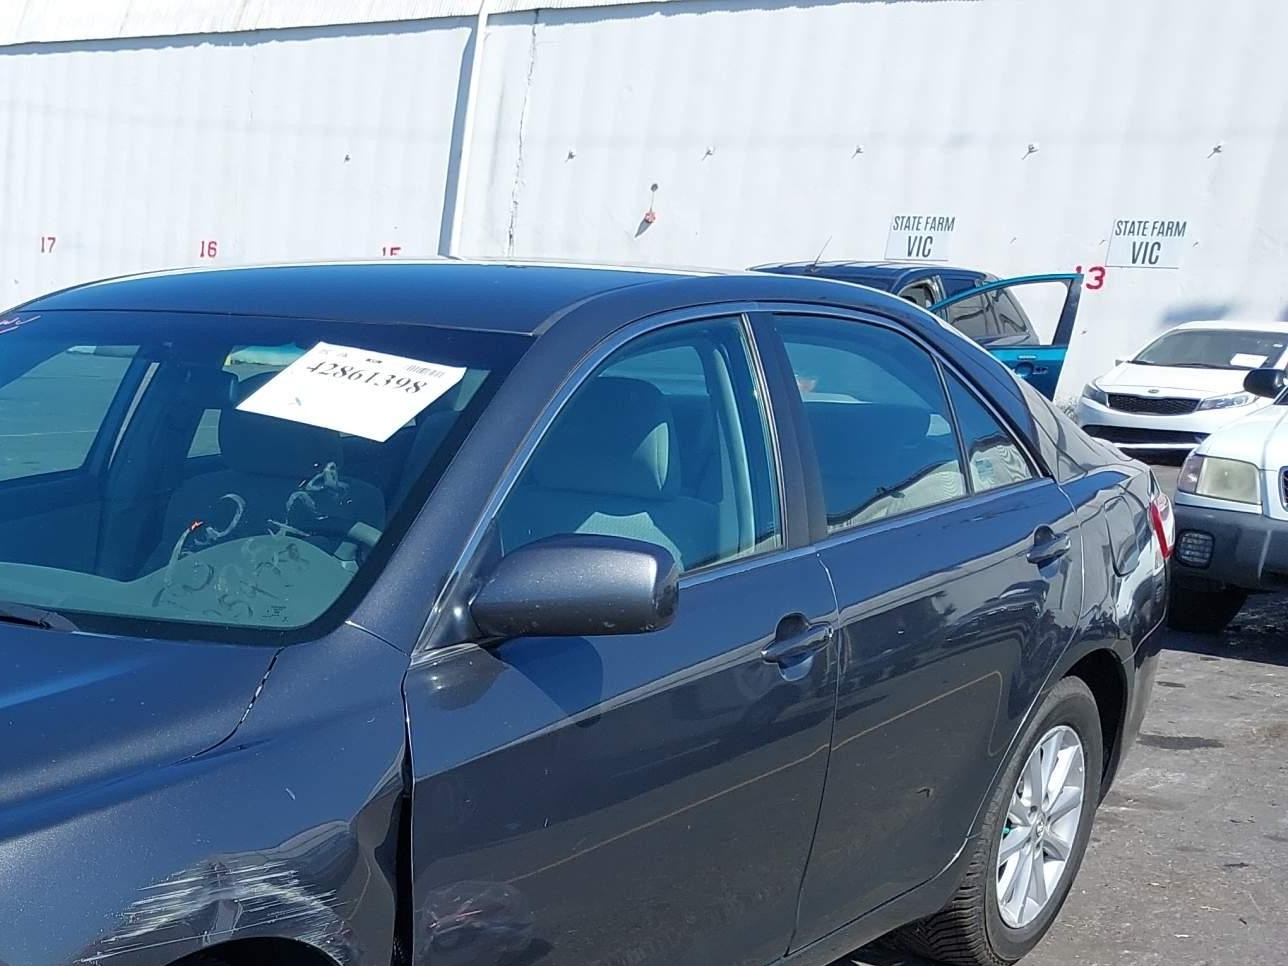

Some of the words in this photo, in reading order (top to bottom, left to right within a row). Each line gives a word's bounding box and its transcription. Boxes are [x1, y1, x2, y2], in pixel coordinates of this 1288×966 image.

[892, 215, 923, 231] STATE
[924, 215, 956, 232] FARM
[1114, 219, 1150, 237] STATE
[1150, 219, 1187, 238] FARM
[40, 236, 57, 254] 17
[199, 240, 219, 258] 16
[907, 234, 934, 258] VIC
[1131, 240, 1162, 265] VIC
[306, 361, 428, 394] 42861398
